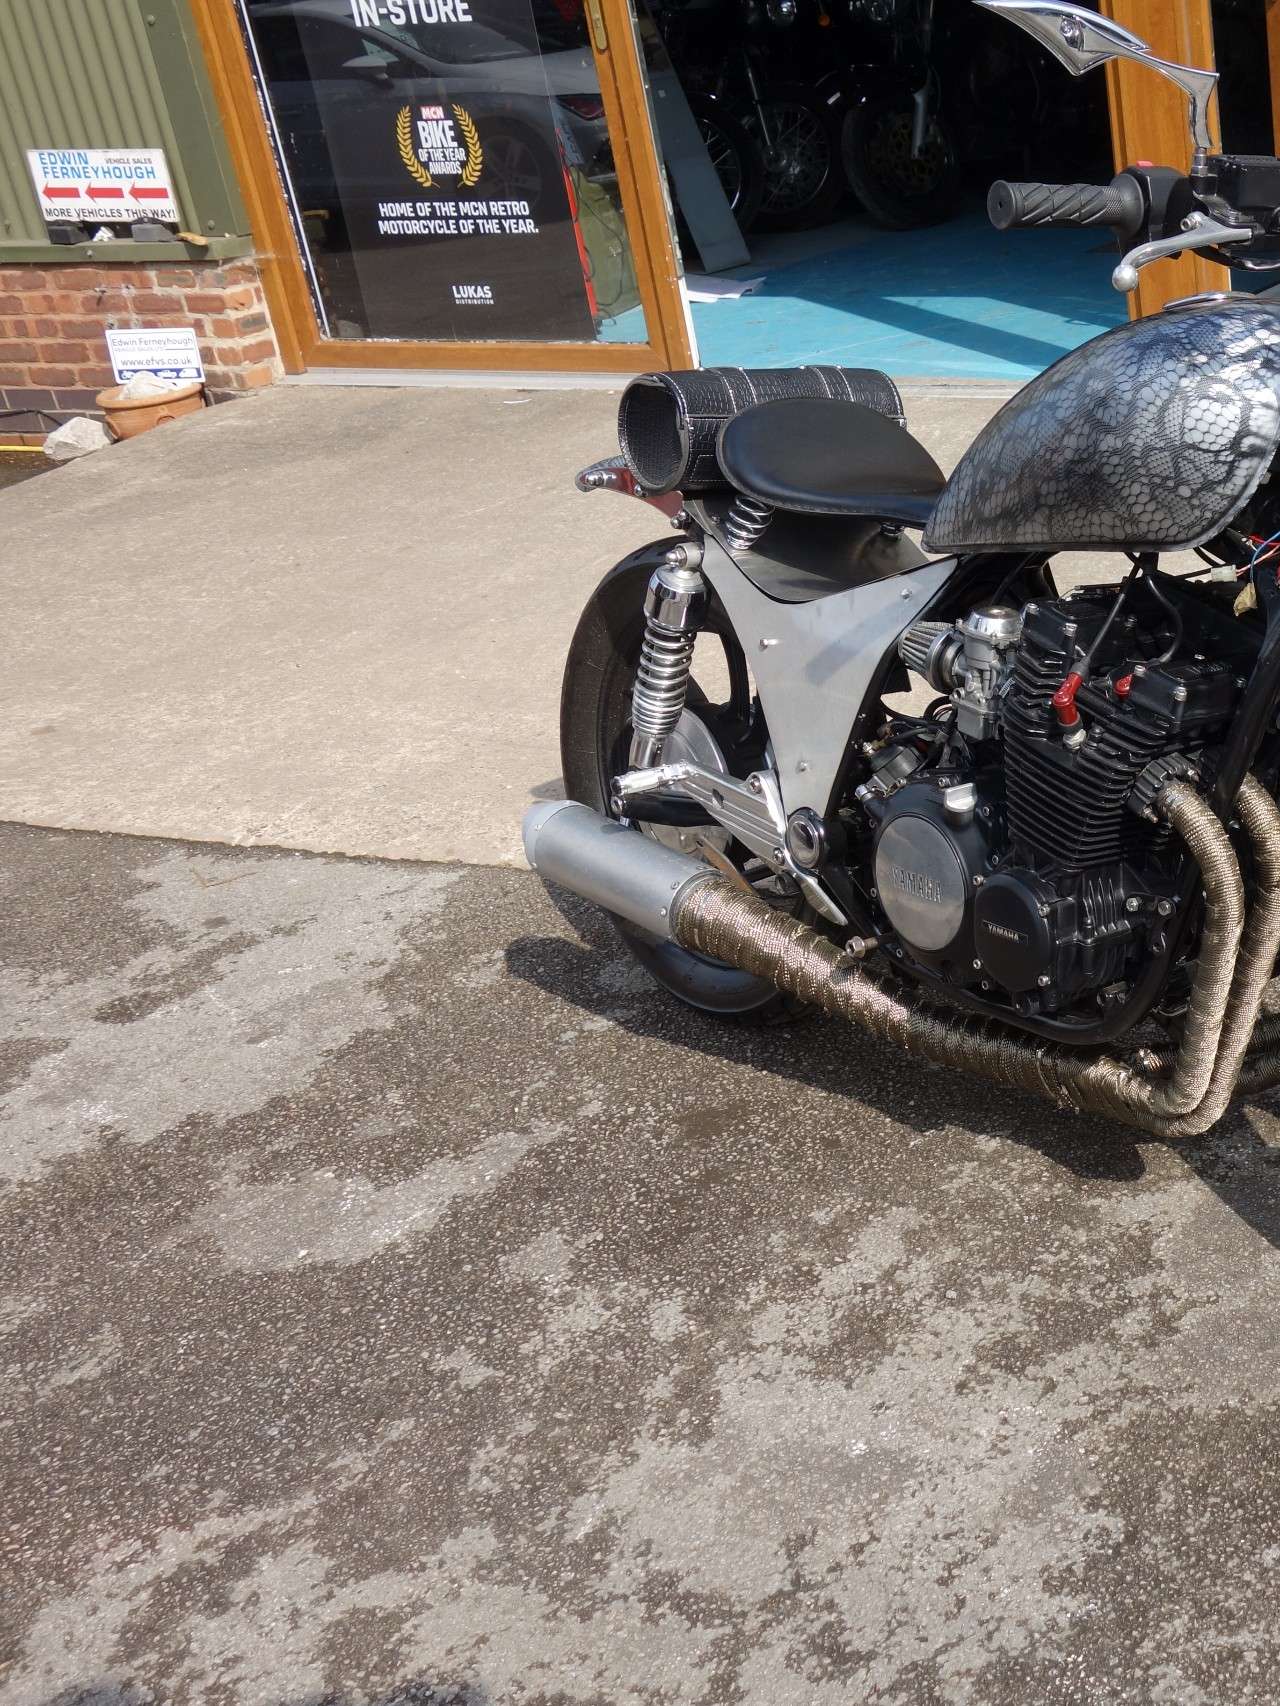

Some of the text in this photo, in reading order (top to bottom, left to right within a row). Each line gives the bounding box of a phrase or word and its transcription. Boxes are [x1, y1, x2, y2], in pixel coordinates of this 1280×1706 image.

[350, 0, 472, 27] IN-STORE
[421, 106, 444, 119] MCN
[417, 120, 458, 148] BIKE
[38, 151, 89, 165] EDWIN
[418, 148, 466, 162] OF THE YEAR
[42, 166, 156, 179] FERNEYHOUGH
[429, 161, 462, 174] AWARDS
[45, 208, 176, 219] MORE VEHICLES THIS WAY!
[378, 201, 530, 217] HOME OF THE MCN RETRO
[378, 219, 539, 234] MOTORCYCLE OF THE YEAR.
[452, 285, 492, 298] LUKAS
[112, 337, 193, 347] Edwin Ferneyhough
[890, 864, 943, 903] YAMAHA
[987, 923, 1020, 942] YAMAHA
